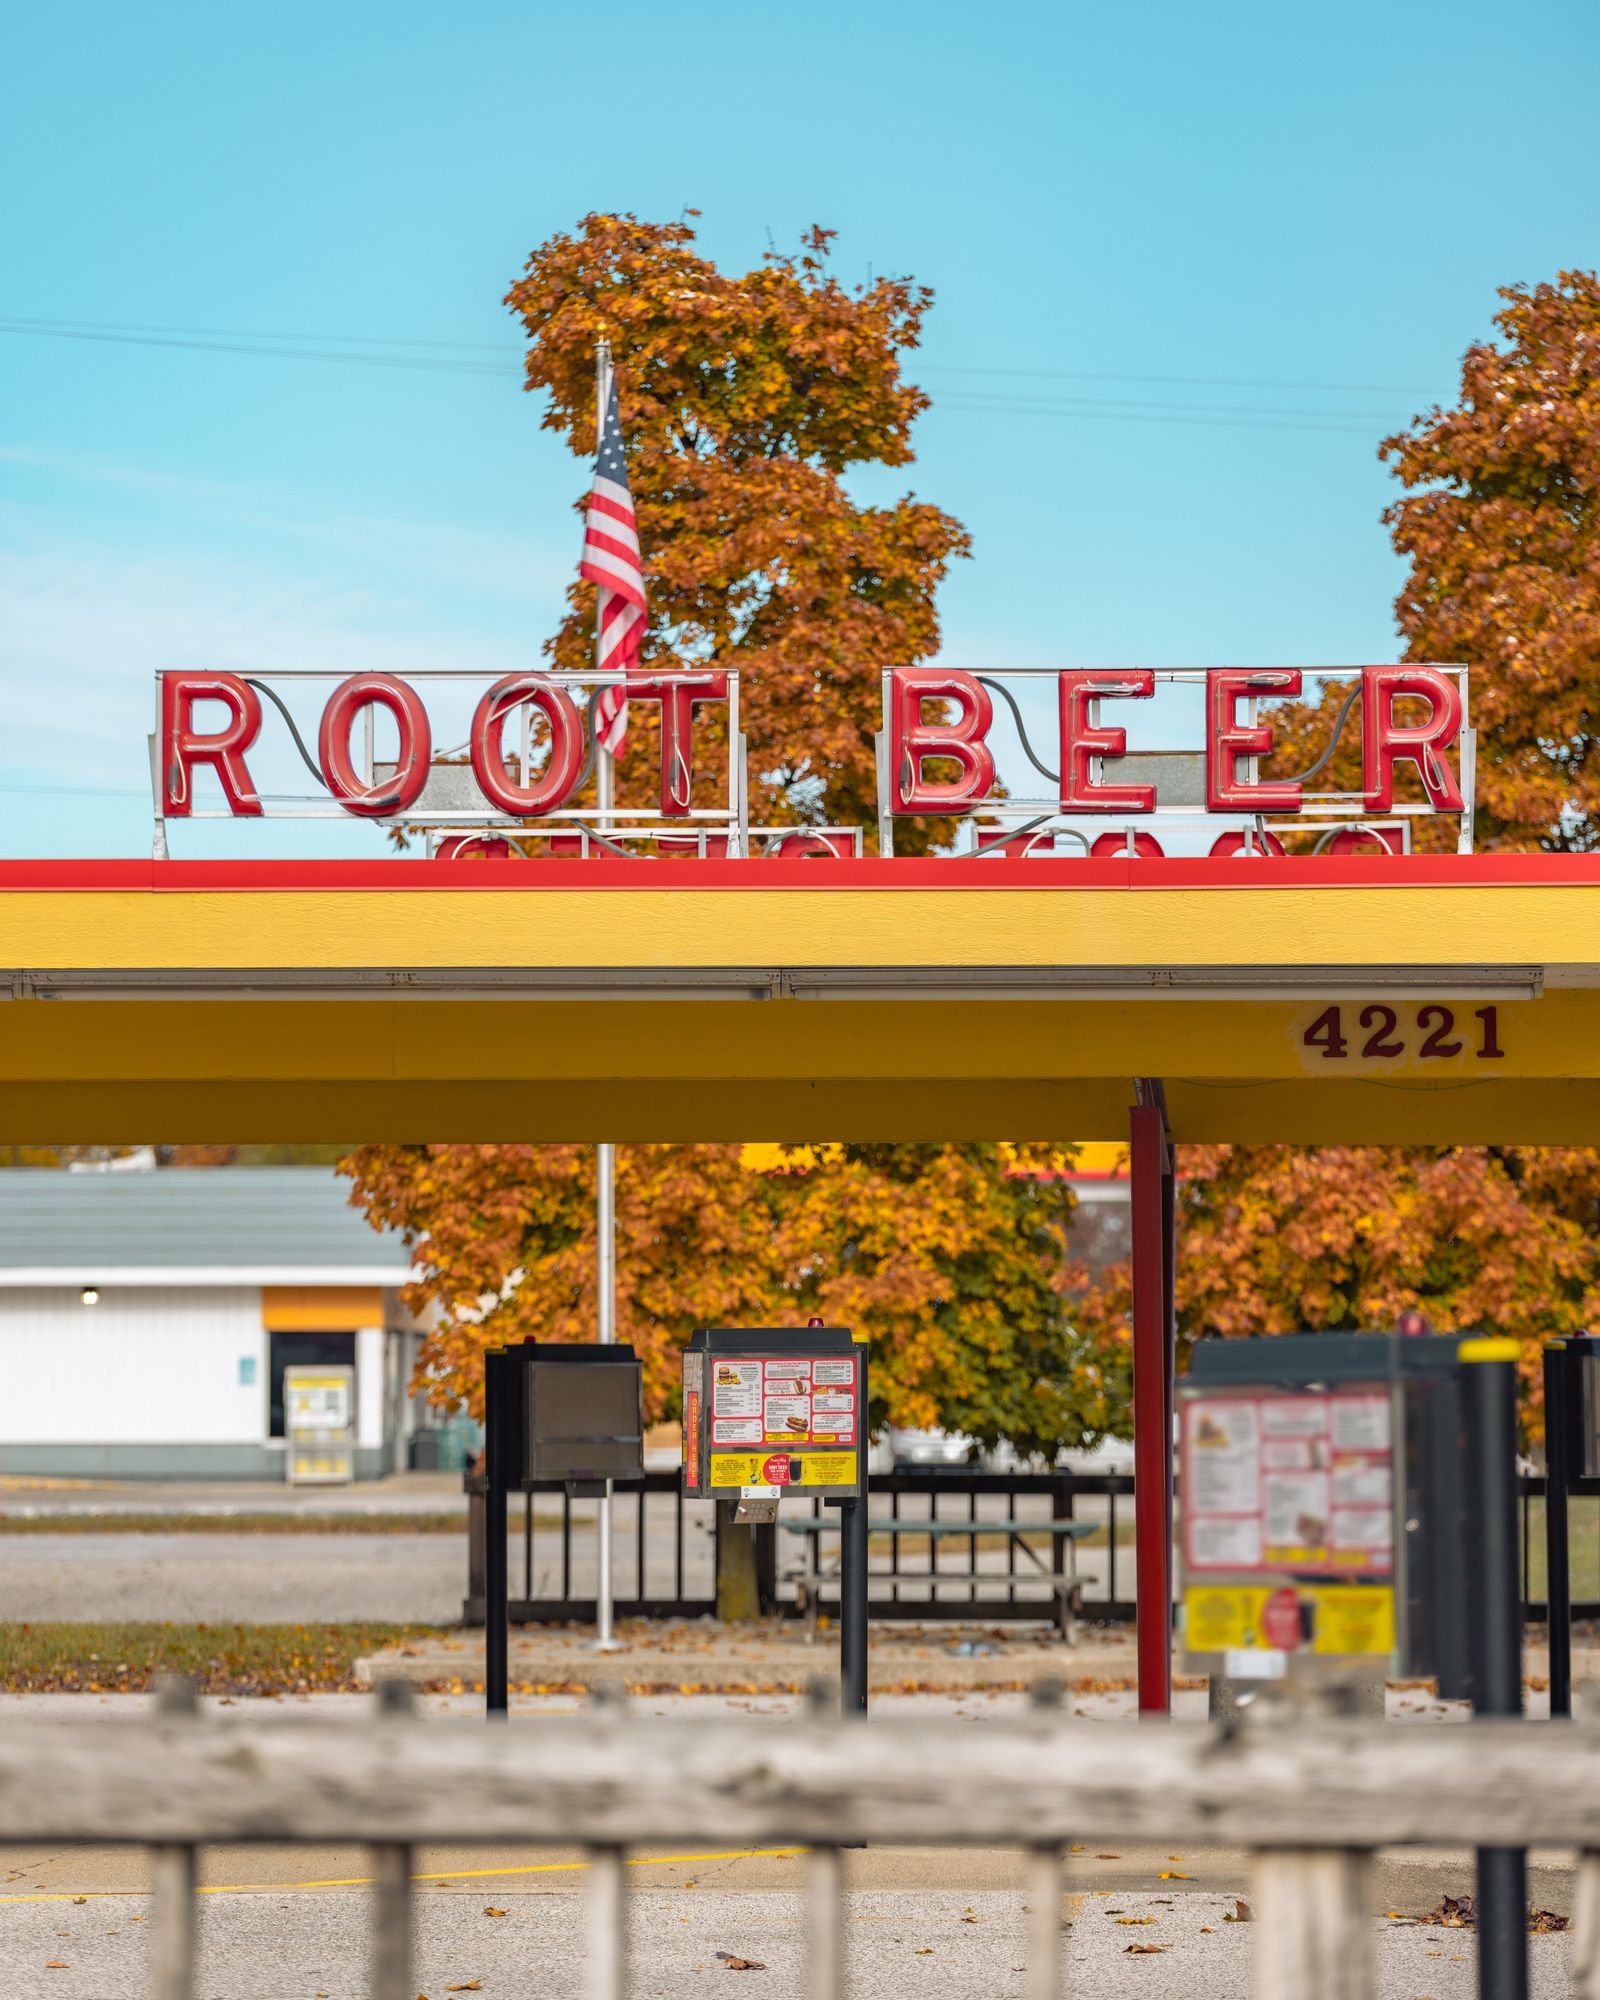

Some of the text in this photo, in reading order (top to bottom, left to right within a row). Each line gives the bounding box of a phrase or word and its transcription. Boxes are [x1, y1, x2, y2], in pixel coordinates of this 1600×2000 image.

[162, 666, 1466, 817] ROOT BEER
[1304, 1005, 1505, 1058] 4221
